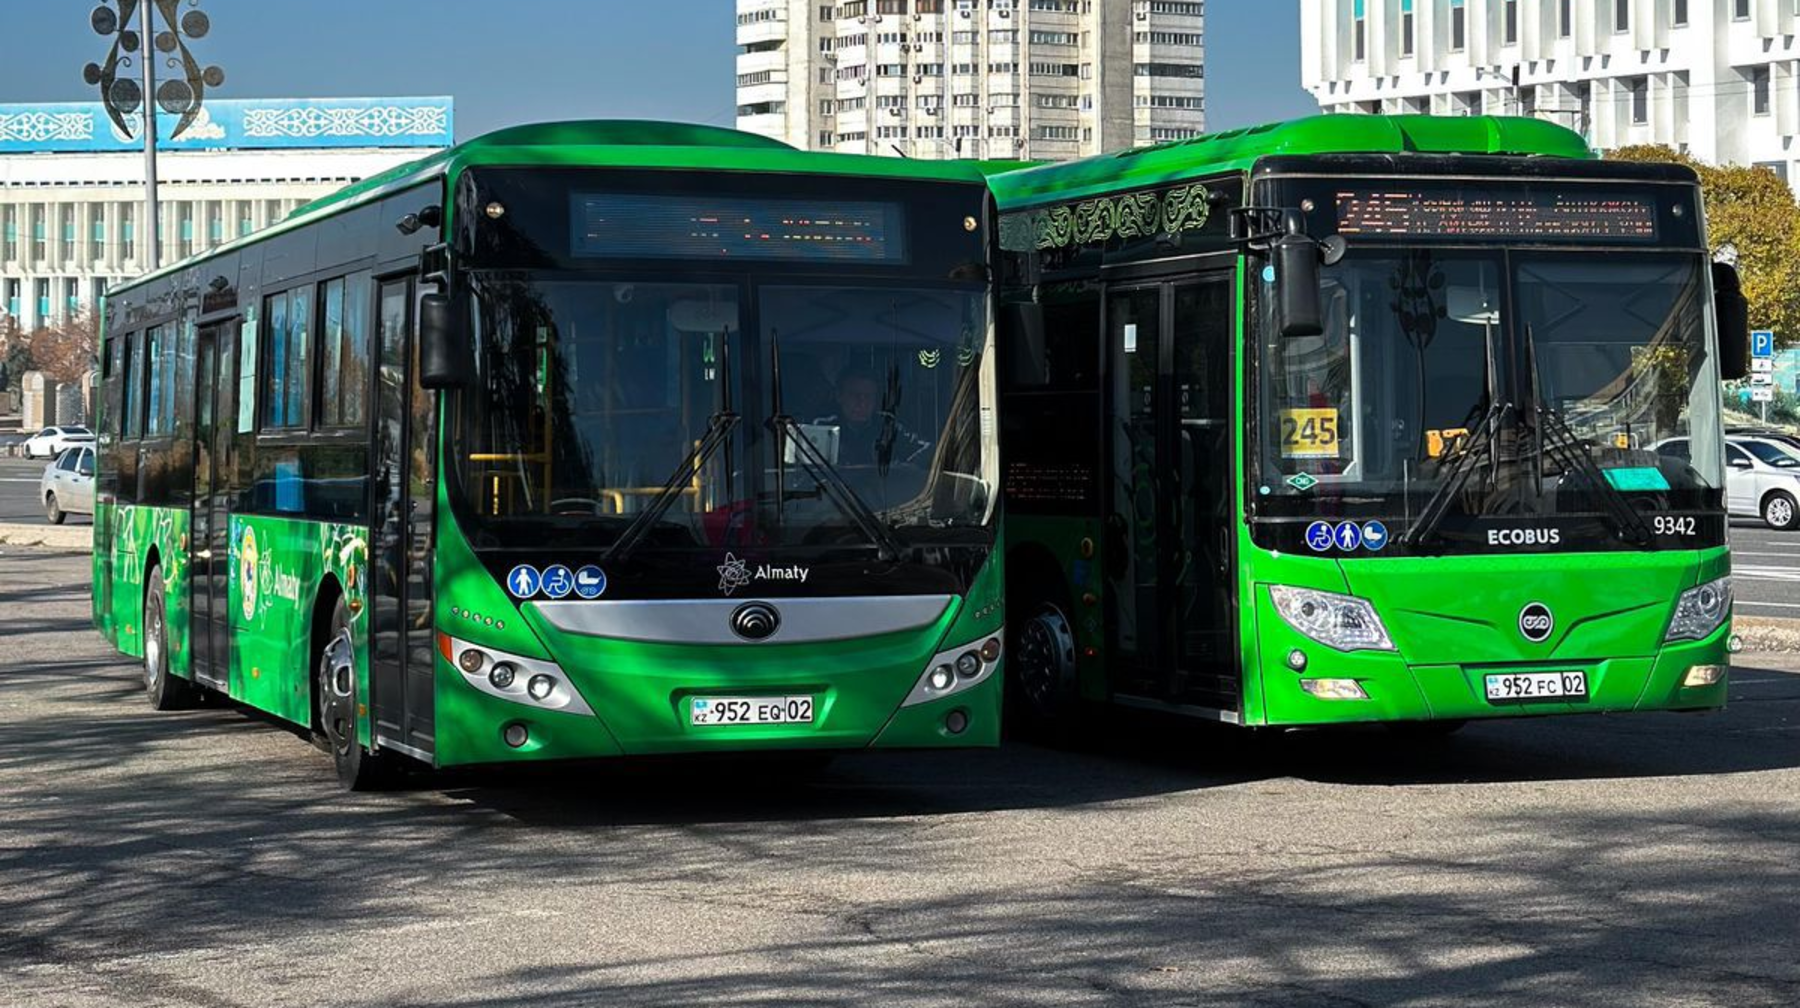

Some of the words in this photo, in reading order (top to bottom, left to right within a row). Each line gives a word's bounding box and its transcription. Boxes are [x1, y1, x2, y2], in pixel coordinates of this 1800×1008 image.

[1756, 335, 1767, 353] P
[1283, 417, 1335, 446] 245
[1653, 516, 1696, 535] 9342
[1487, 528, 1560, 545] ECOBUS
[754, 564, 809, 583] Almaty
[273, 562, 301, 610] Almaty
[1489, 687, 1500, 697] KZ
[1502, 677, 1532, 695] 952
[1537, 680, 1557, 694] FC
[1563, 674, 1584, 693] 02
[694, 713, 708, 722] KZ
[715, 701, 751, 722] 952
[758, 704, 781, 721] EQ
[787, 700, 811, 720] 02
